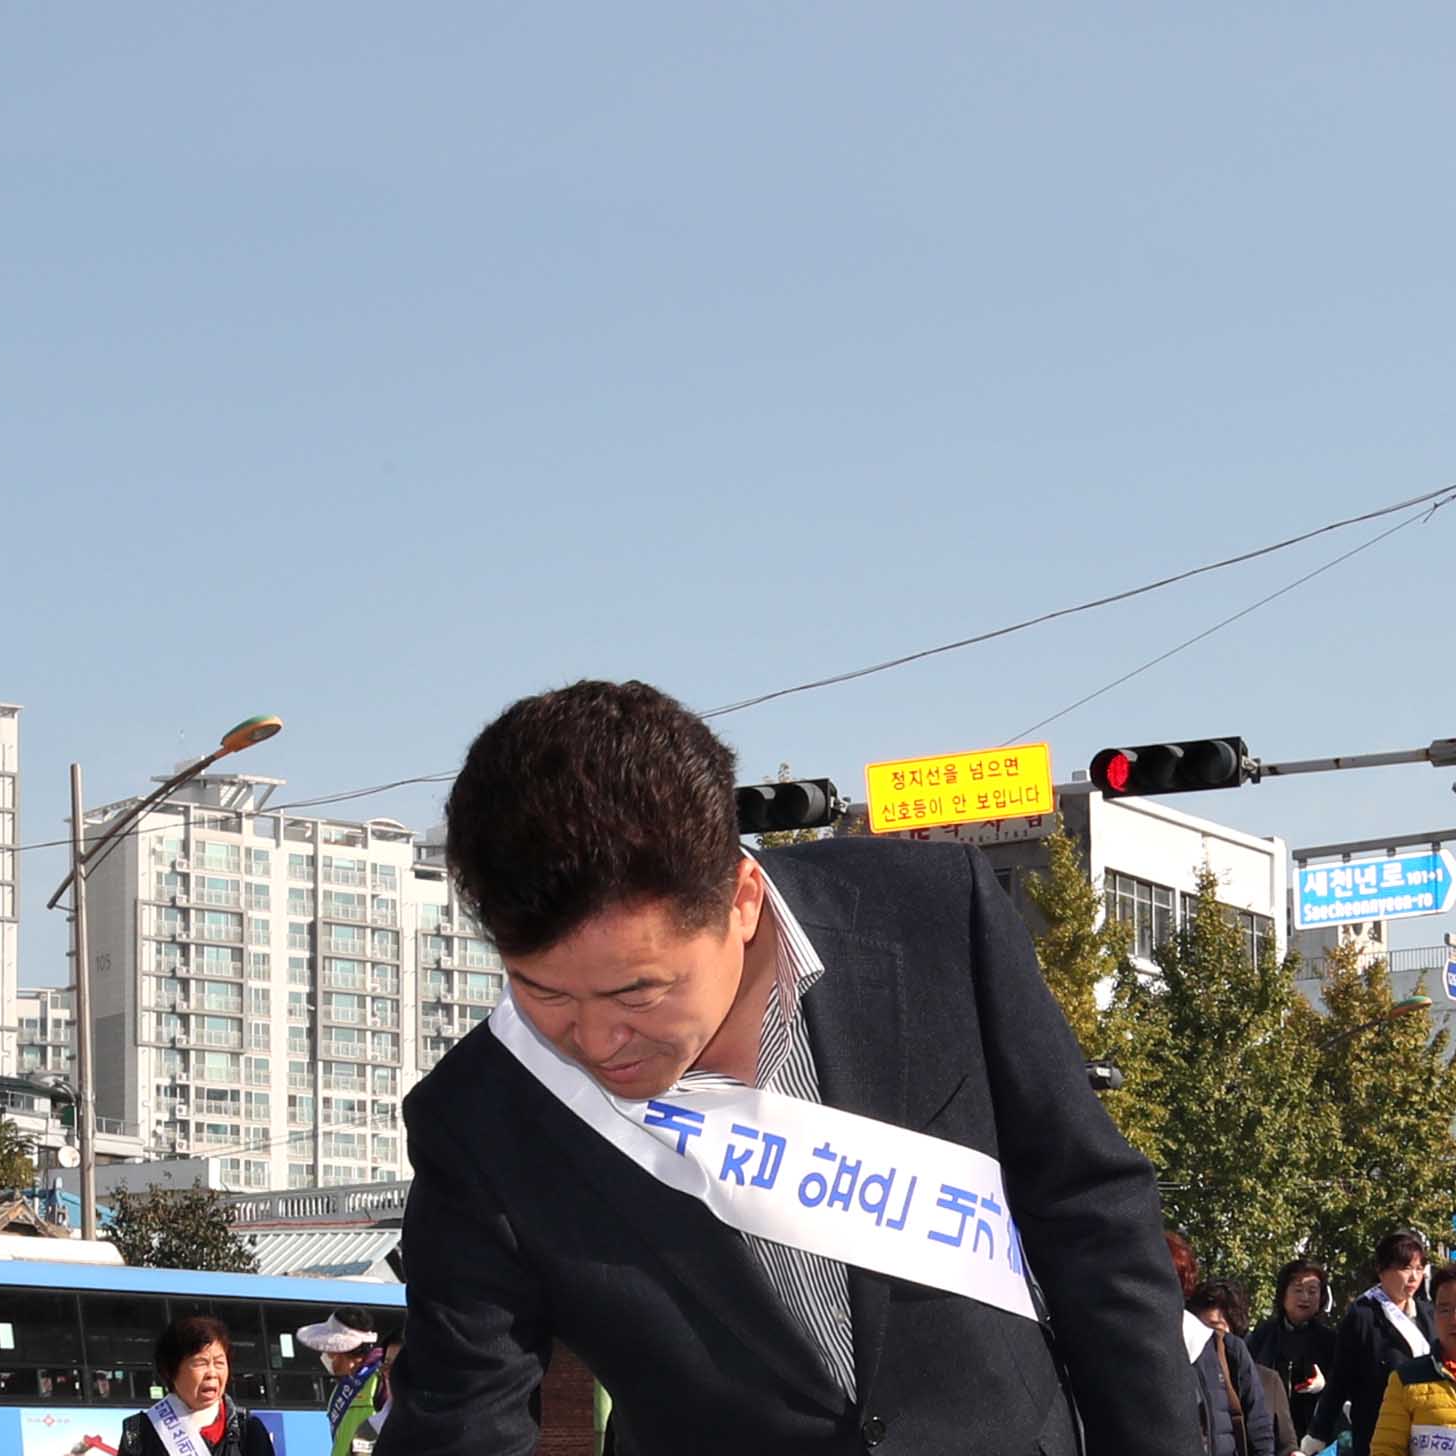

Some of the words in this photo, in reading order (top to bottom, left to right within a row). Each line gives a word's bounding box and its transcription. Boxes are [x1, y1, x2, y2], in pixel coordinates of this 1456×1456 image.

[891, 763, 958, 791] 정지선을
[969, 756, 1019, 782] 넘으면
[882, 797, 943, 823] 신호등이
[952, 794, 967, 815] 안
[976, 784, 1041, 811] 보입니다
[1304, 862, 1405, 898] 새천년로
[720, 1122, 787, 1190] 집
[798, 1141, 917, 1231] 앞은
[927, 1184, 1003, 1262] 내가
